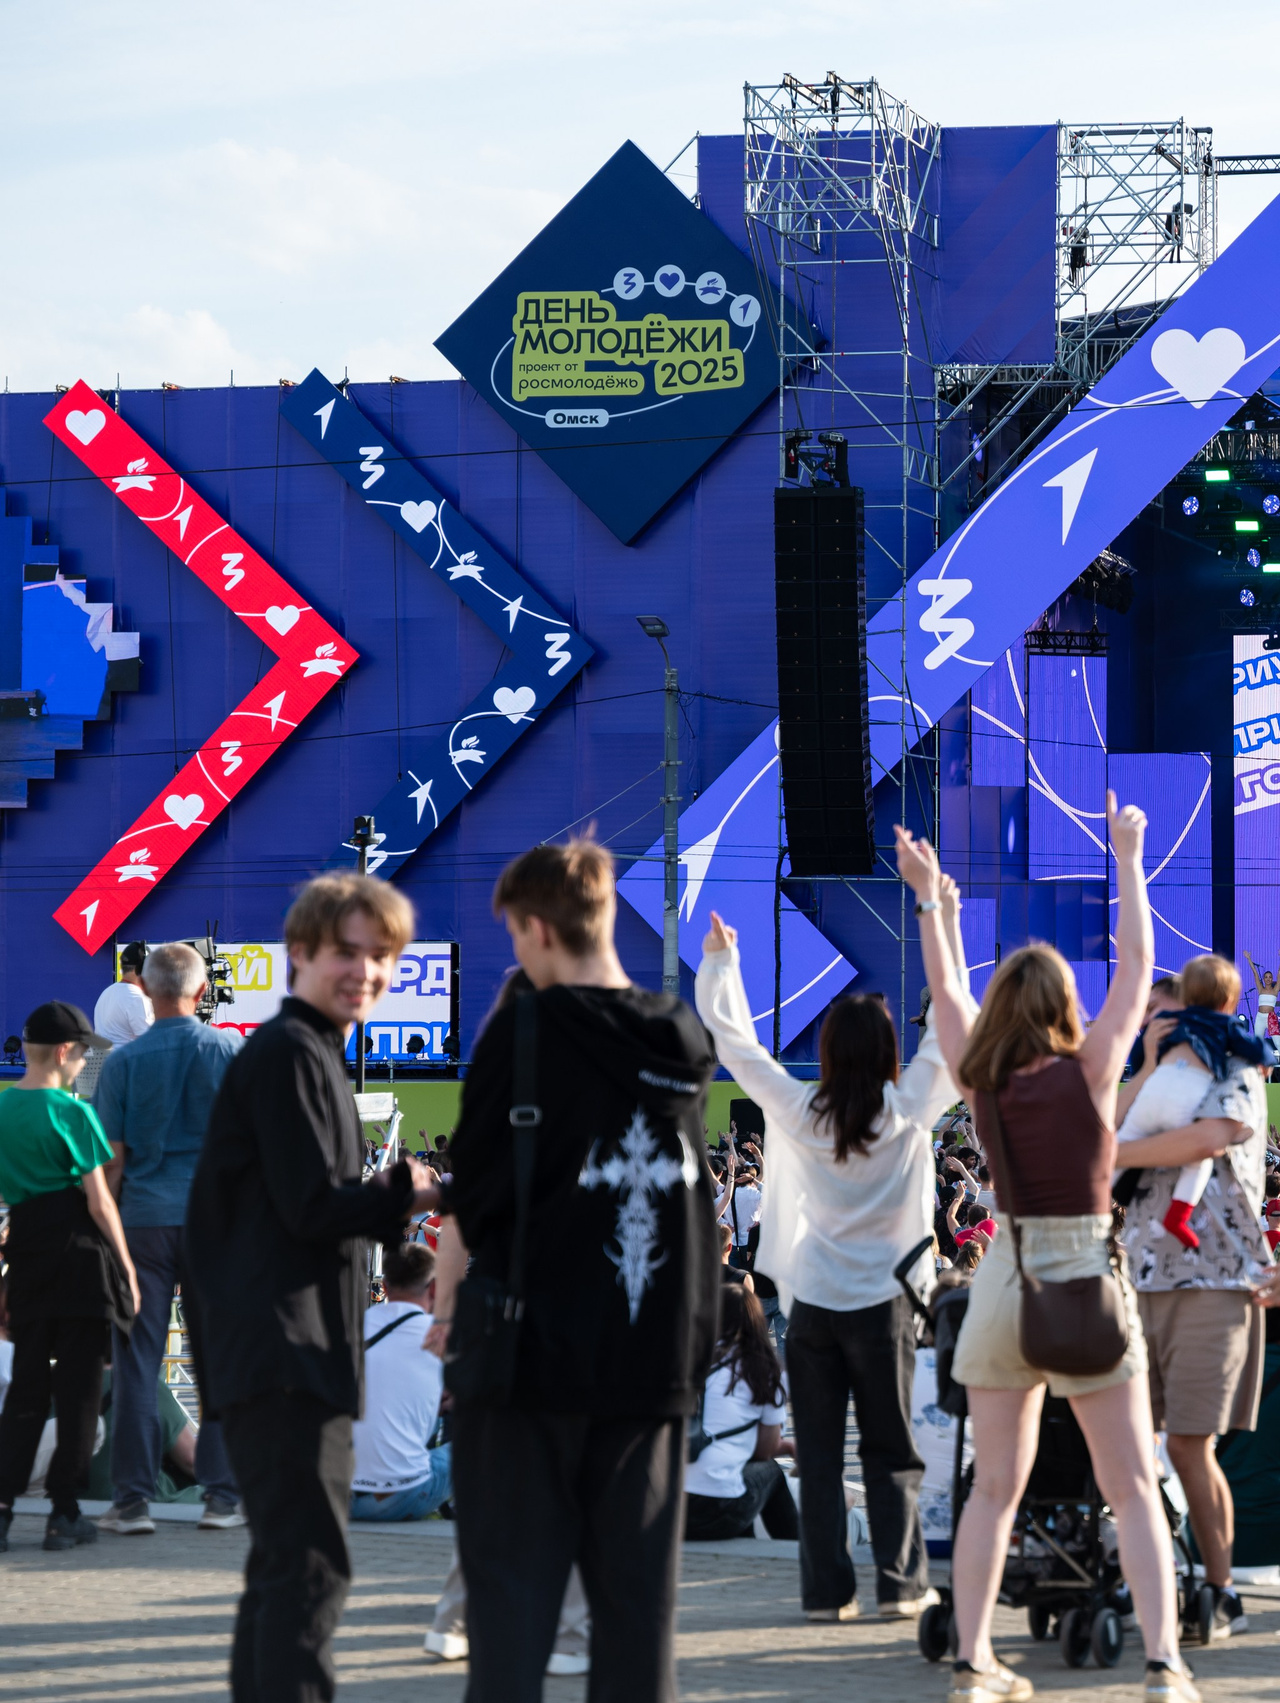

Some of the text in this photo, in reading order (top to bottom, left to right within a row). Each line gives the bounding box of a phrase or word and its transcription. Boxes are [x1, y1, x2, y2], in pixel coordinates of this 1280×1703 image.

[520, 298, 610, 329] ДЕНЬ
[519, 320, 723, 358] МОЛОДЁЖИ
[518, 362, 579, 374] проект от
[661, 355, 739, 388] 2025
[518, 376, 639, 394] росмолодёжь
[553, 412, 600, 425] Омск
